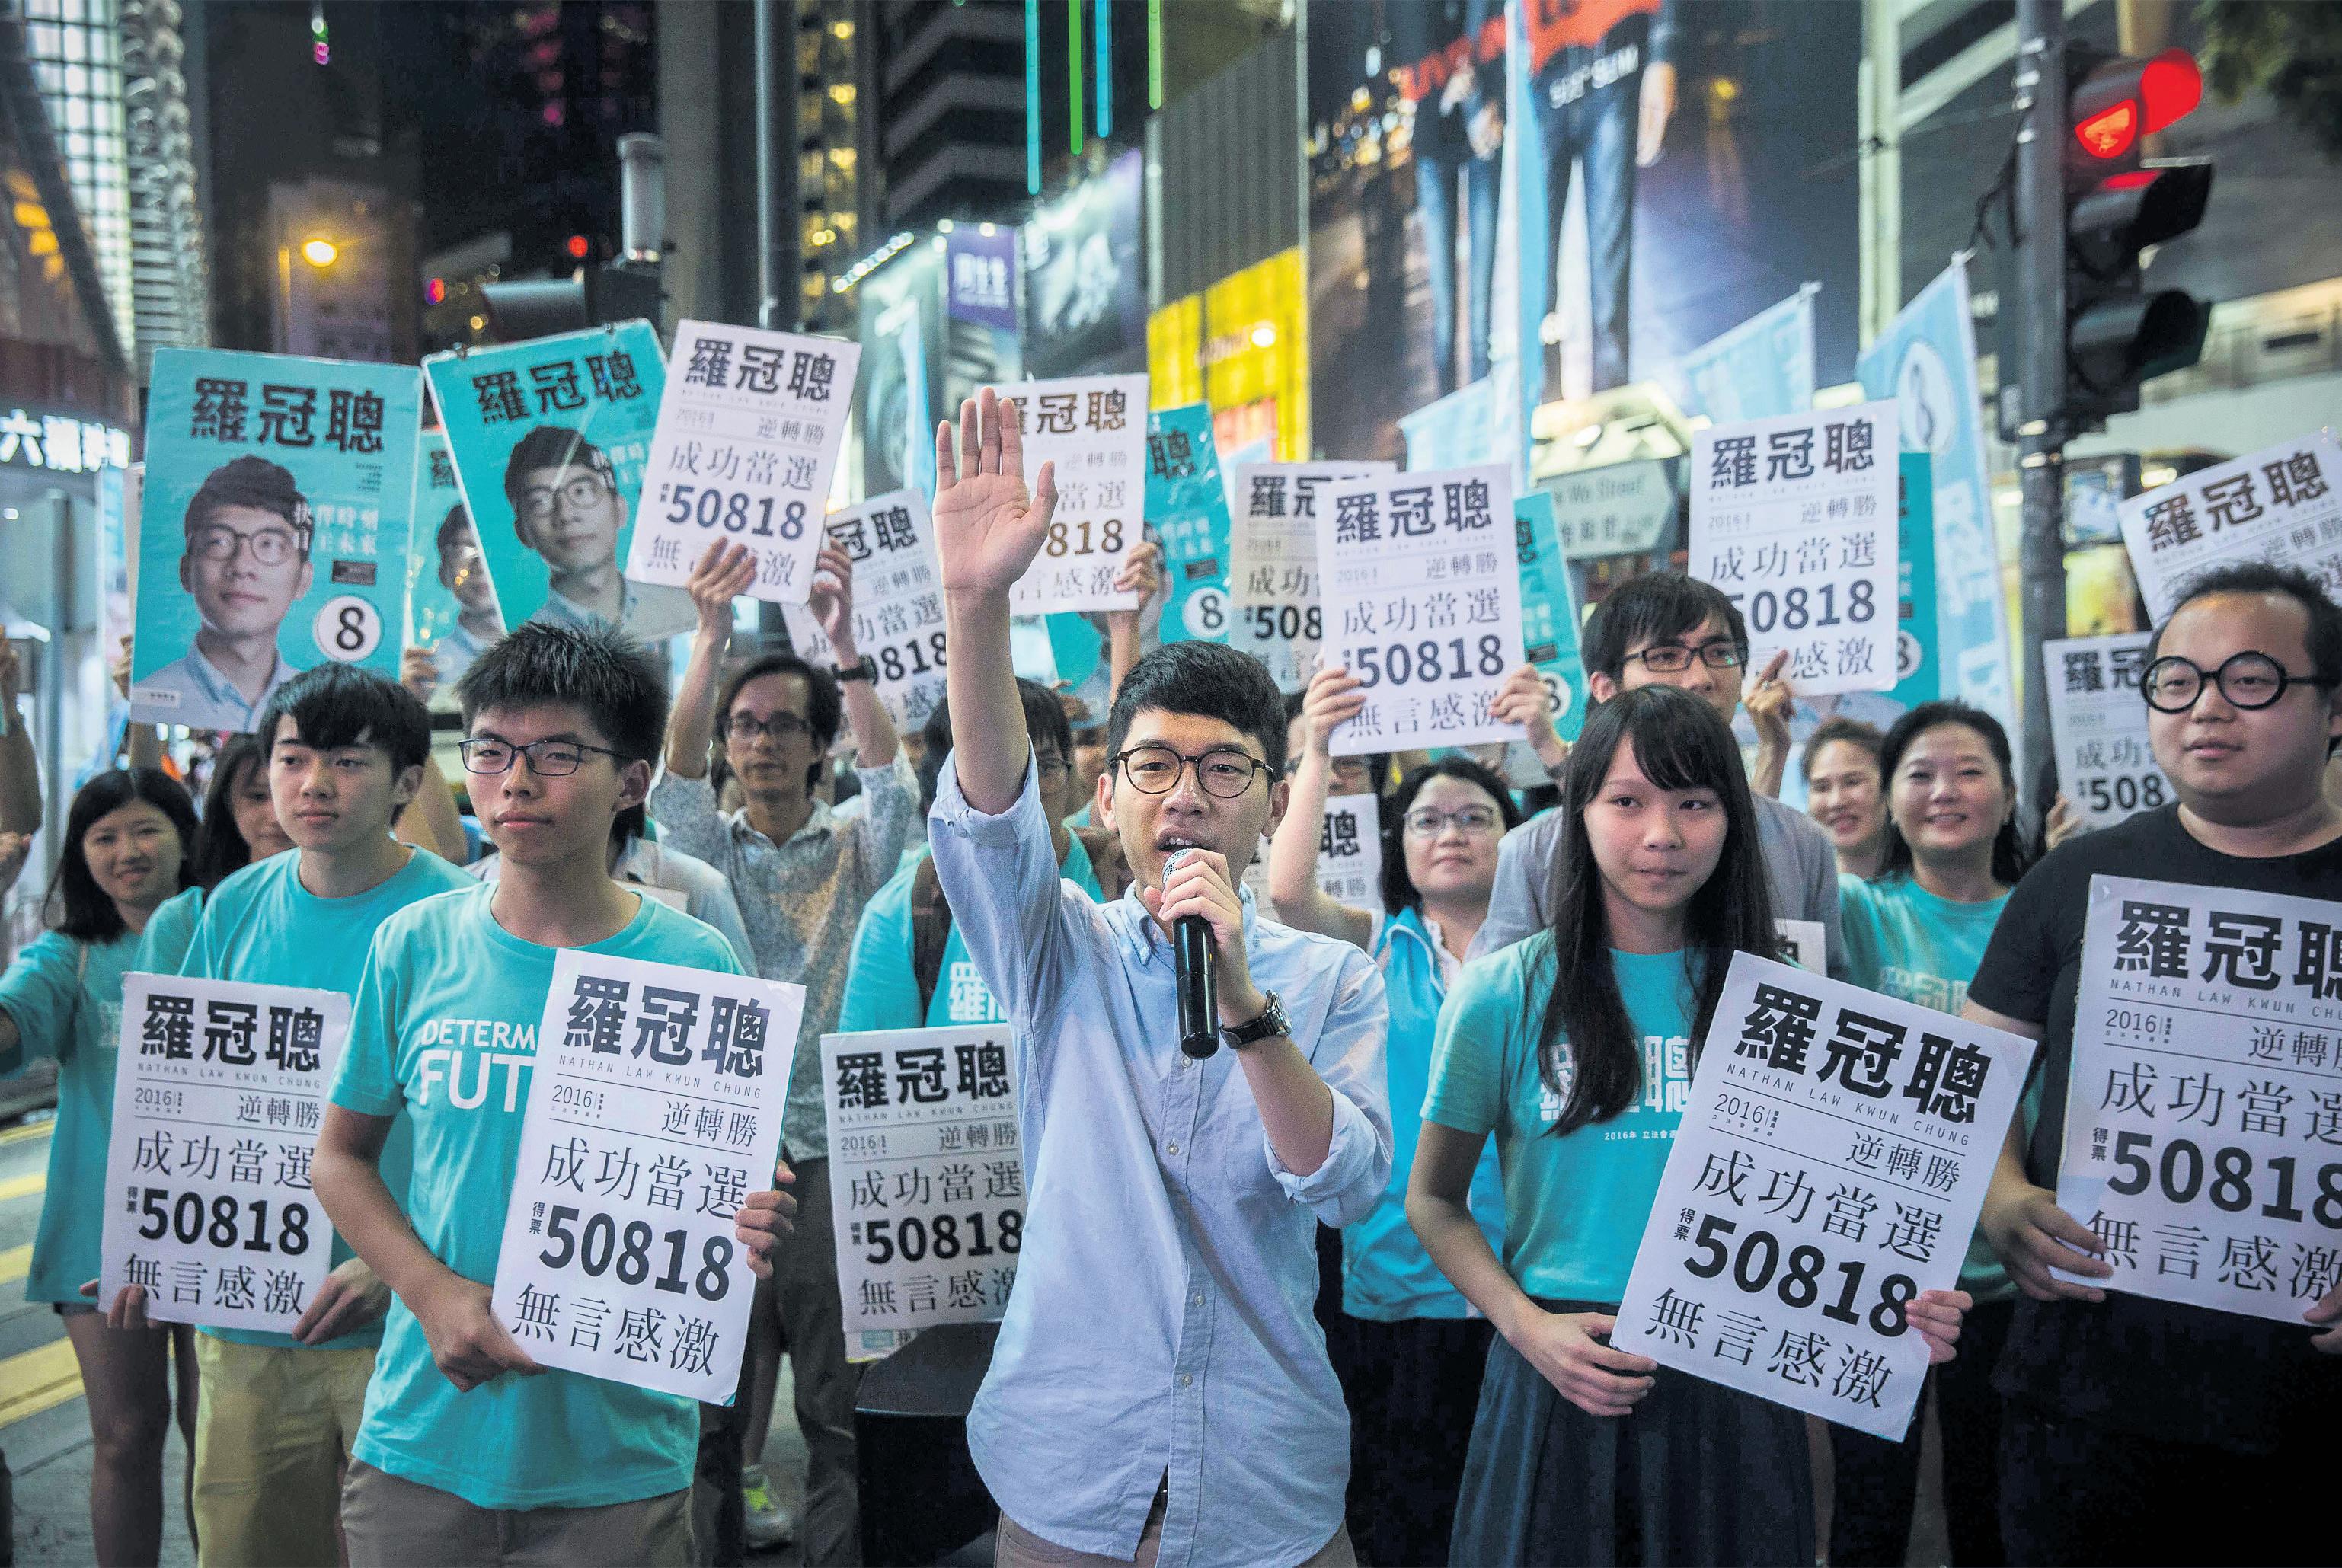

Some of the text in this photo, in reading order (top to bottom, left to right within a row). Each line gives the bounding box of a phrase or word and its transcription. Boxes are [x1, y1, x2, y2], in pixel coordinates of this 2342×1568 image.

[472, 351, 642, 424] 羅冠聰
[686, 338, 838, 402] 羅冠聰
[190, 377, 385, 455] 羅冠聰
[669, 440, 818, 492] 成功當選
[1711, 418, 1875, 490] 羅冠聰
[666, 484, 807, 541] 50818
[1336, 477, 1492, 544] 羅冠聰
[2144, 450, 2328, 551] 羅冠聰
[1046, 519, 1123, 557] 818
[1711, 532, 1877, 583] 成功當選
[337, 606, 364, 650] 8
[1200, 595, 1223, 630] 8
[1255, 605, 1322, 640] 508
[1343, 586, 1501, 635] 成功當選
[1730, 580, 1876, 634] 0818
[874, 631, 947, 685] 818
[1358, 634, 1504, 688] 50818
[2091, 774, 2163, 811] 508
[2105, 1009, 2157, 1033] 2016
[2110, 979, 2181, 998] NATHAN
[2197, 990, 2232, 1005] LAW
[2248, 997, 2295, 1014] KWUN
[140, 994, 324, 1072] 羅冠聰
[420, 1019, 536, 1051] DETERM
[563, 975, 771, 1078] 羅冠聰
[1733, 982, 1992, 1124] 羅冠聰
[135, 1087, 171, 1106] 2016
[138, 1063, 321, 1089] NATHAN LAW KWUN CHUNG
[420, 1049, 534, 1112] FUT
[551, 1085, 593, 1108] 2016
[559, 1055, 761, 1098] NATHAN LAW KWUN CHUNG
[836, 1040, 1010, 1110] 羅冠聰
[237, 1094, 321, 1129] 逆轉勝
[662, 1100, 758, 1147] 逆轉勝
[1714, 1094, 1765, 1123] 2016
[1727, 1063, 1970, 1146] NATHAN LAW KWUN CHUNG
[2101, 1062, 2342, 1144] 成功當選
[131, 1131, 315, 1190] 成功當選
[841, 1135, 877, 1151] 2016
[938, 1121, 1017, 1150] 逆轉勝
[1846, 1130, 1960, 1192] 逆轉勝
[2091, 1127, 2108, 1162] 得票
[541, 1136, 748, 1221] 成功當選
[851, 1158, 1021, 1211] 成功當選
[2107, 1131, 2342, 1230] 50818
[139, 1189, 310, 1255] 50818
[529, 1201, 545, 1234] 得票
[1673, 1206, 1695, 1242] 得票
[1692, 1150, 1944, 1263] 成功當選
[538, 1204, 733, 1301] 50818
[866, 1208, 1023, 1266] 50818
[2088, 1210, 2342, 1301] 無言感激
[123, 1253, 305, 1315] 無言感激
[1682, 1215, 1918, 1338] 50818
[511, 1283, 720, 1376] 無言感激
[1644, 1286, 1893, 1410] 無言感激
